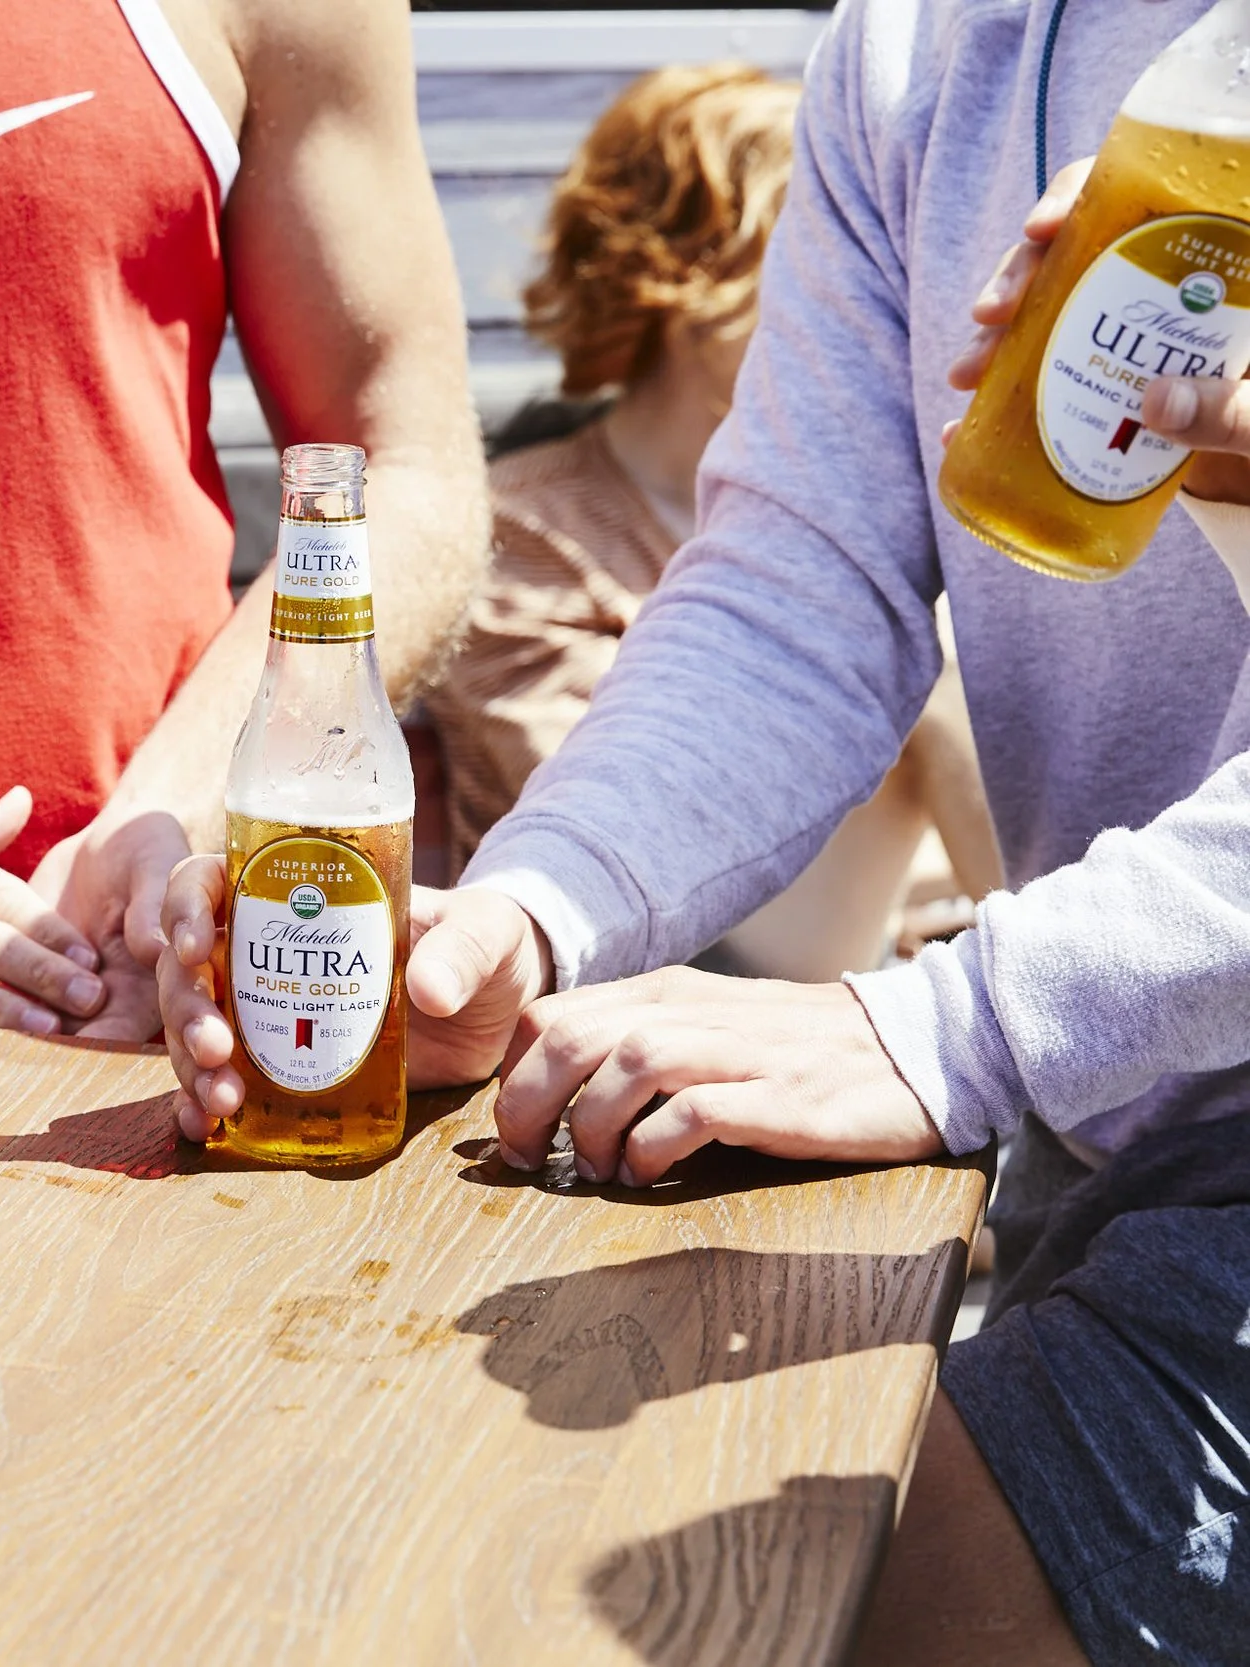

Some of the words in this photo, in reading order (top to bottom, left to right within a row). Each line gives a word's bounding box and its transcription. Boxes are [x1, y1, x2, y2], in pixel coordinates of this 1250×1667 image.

[1180, 232, 1250, 267] SUPERIO
[1122, 299, 1232, 350] Michelob
[1092, 312, 1225, 378] ULTRA
[1054, 359, 1120, 403] ORGANIC
[1088, 354, 1149, 392] PURE
[287, 552, 358, 571] ULTRA
[284, 574, 318, 587] PURE
[323, 576, 359, 587] GOLD
[317, 612, 349, 621] LIGHT
[267, 868, 308, 881] LIGHT
[317, 873, 354, 882] BEER
[273, 859, 346, 872] SUPERIOR
[298, 893, 317, 902] USDA
[261, 921, 352, 945] Michelob
[248, 941, 370, 976] ULTRA
[256, 976, 302, 995] PURE
[309, 982, 361, 996] GOLD
[237, 990, 288, 1009] ORGANIC
[293, 1001, 335, 1012] LIGHT
[340, 999, 380, 1011] LAGER
[255, 1020, 265, 1030] 2.5
[266, 1022, 289, 1036] CARBS
[320, 1028, 331, 1038] 85
[332, 1028, 352, 1038] CALS
[290, 1059, 297, 1067] 12
